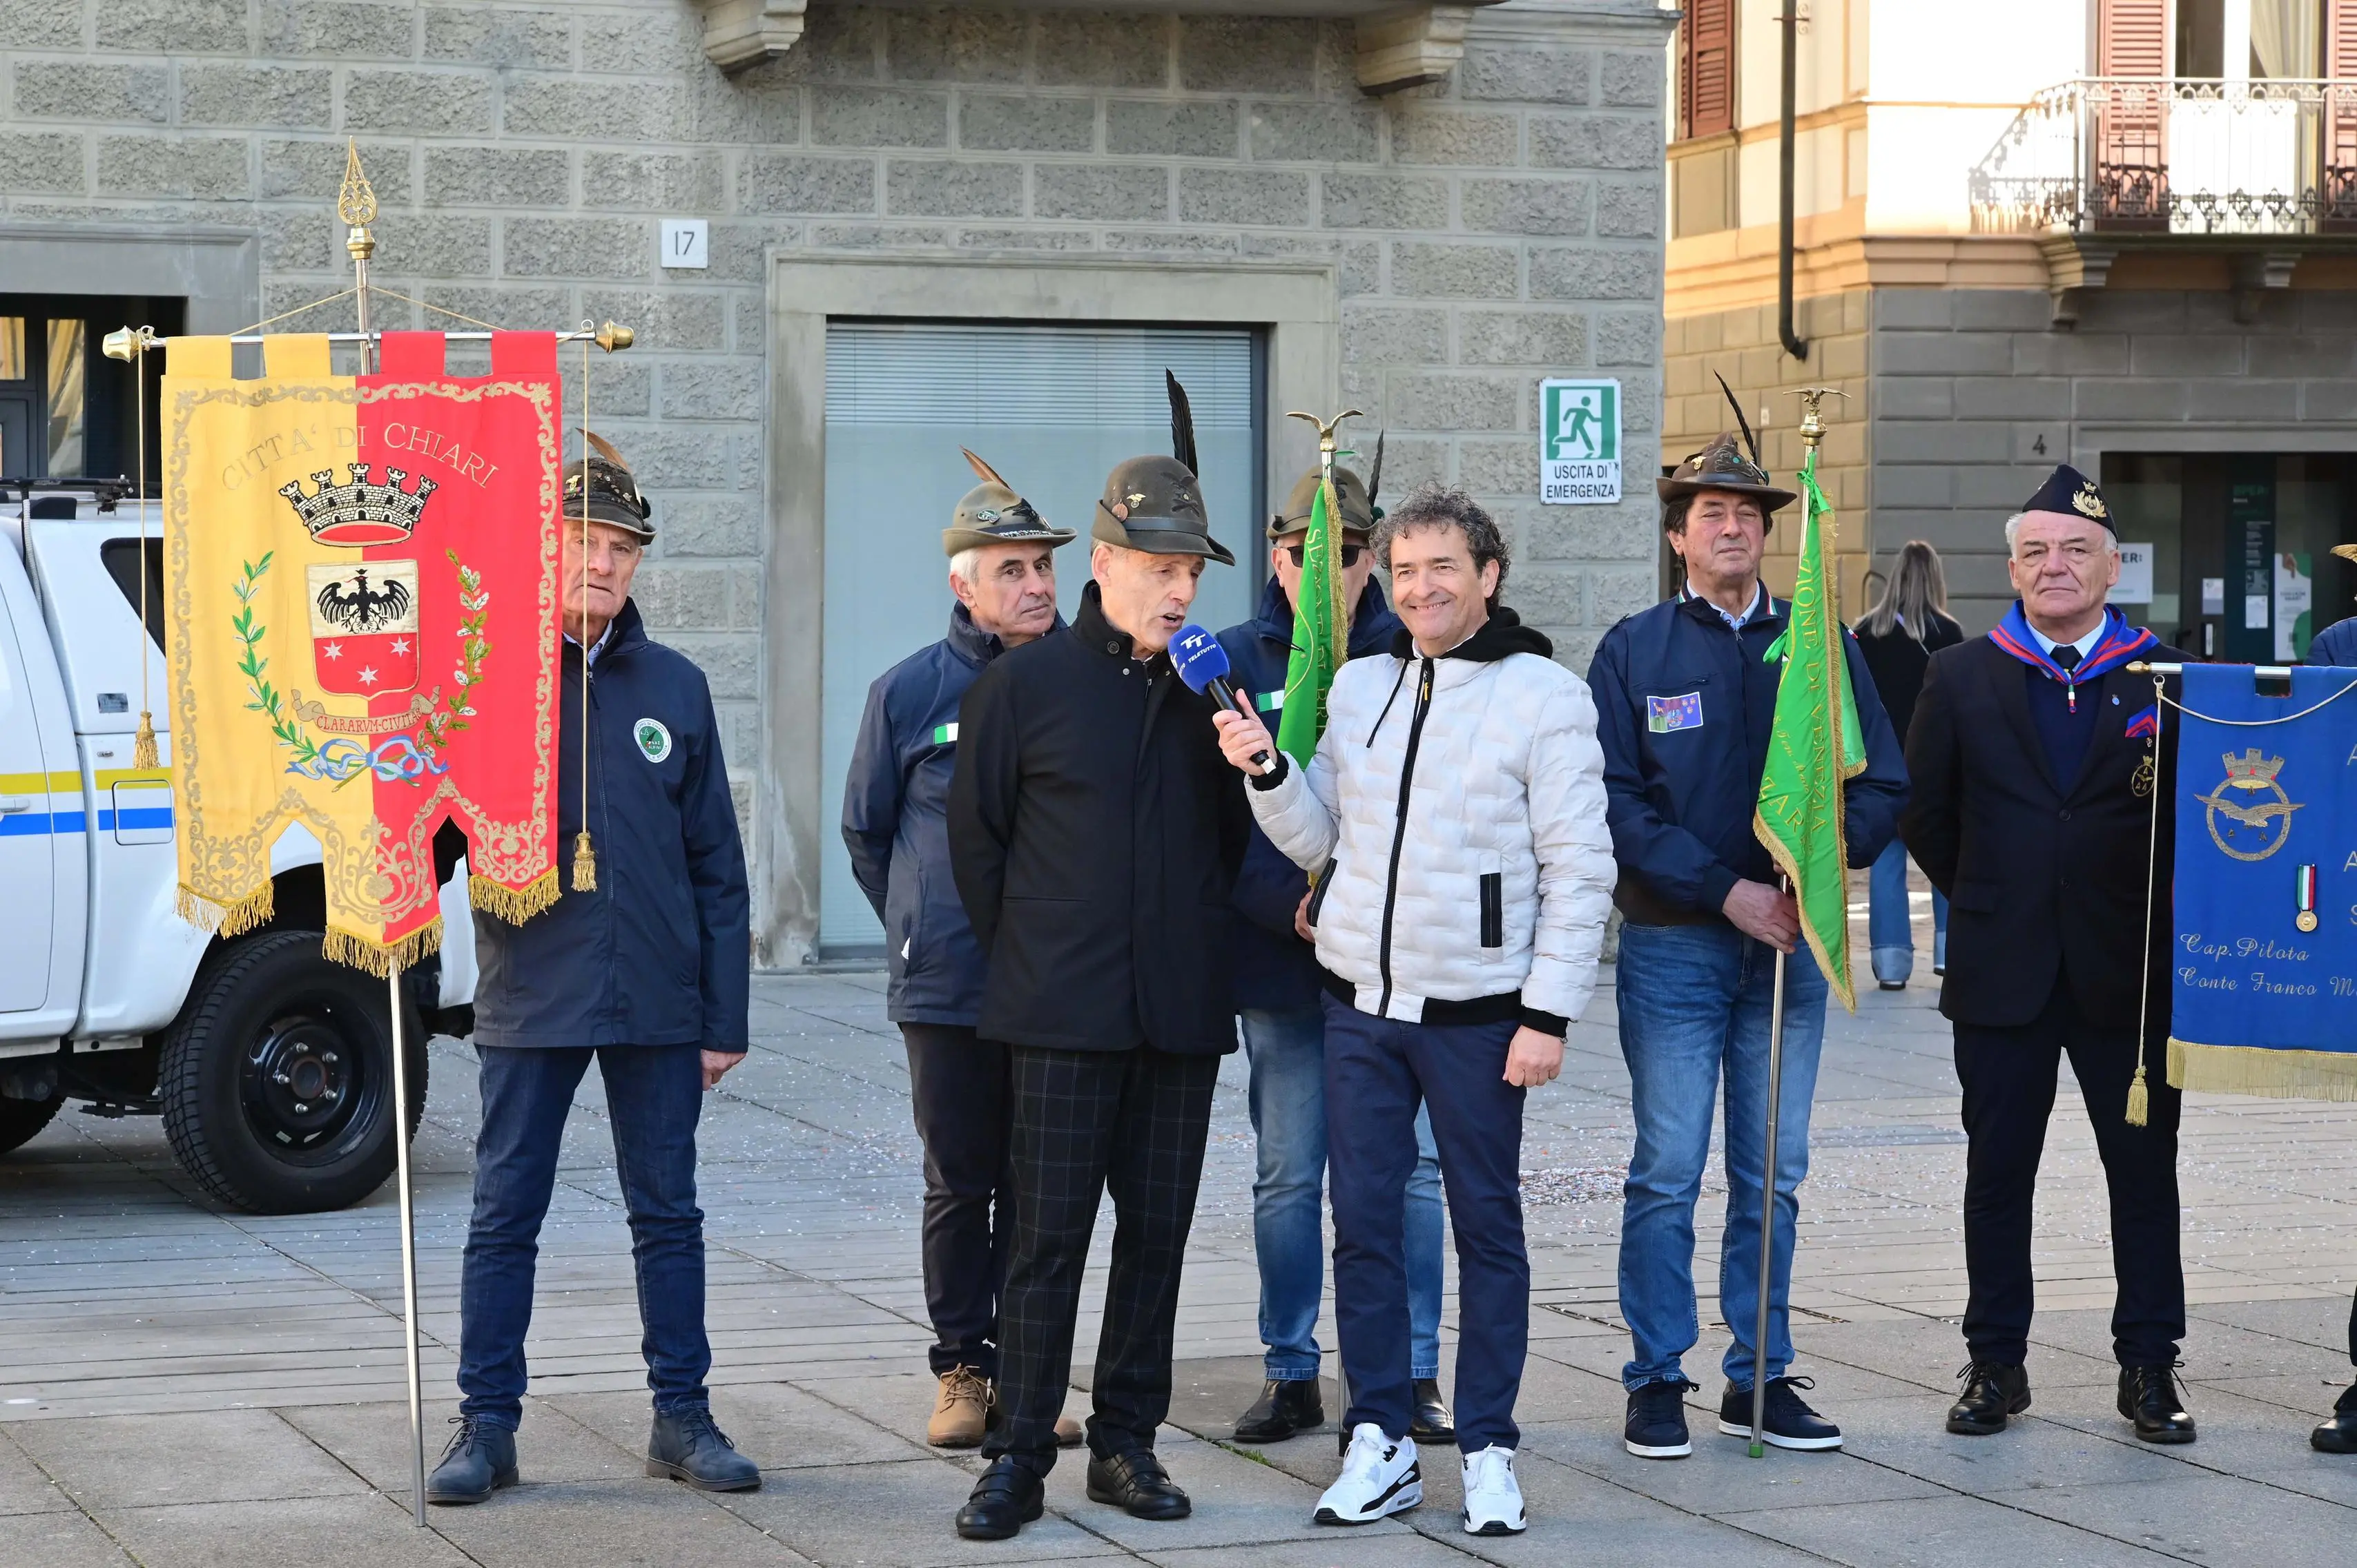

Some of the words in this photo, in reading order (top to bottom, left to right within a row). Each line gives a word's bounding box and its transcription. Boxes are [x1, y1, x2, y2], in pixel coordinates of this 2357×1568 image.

[675, 230, 695, 255] 17
[335, 425, 367, 447] DI
[384, 422, 499, 489] CHIARI
[2032, 434, 2047, 456] 4
[1554, 465, 1593, 478] USCITA
[1598, 465, 1607, 478] DI
[1546, 484, 1615, 498] EMERGENZA
[2122, 553, 2142, 563] ER:
[1188, 643, 1216, 663] TELETUTTO
[1806, 662, 1821, 691] DI
[2180, 933, 2232, 962] Cap.
[2178, 967, 2238, 990] Conte
[2251, 972, 2317, 995] Franco
[2329, 976, 2357, 996] M
